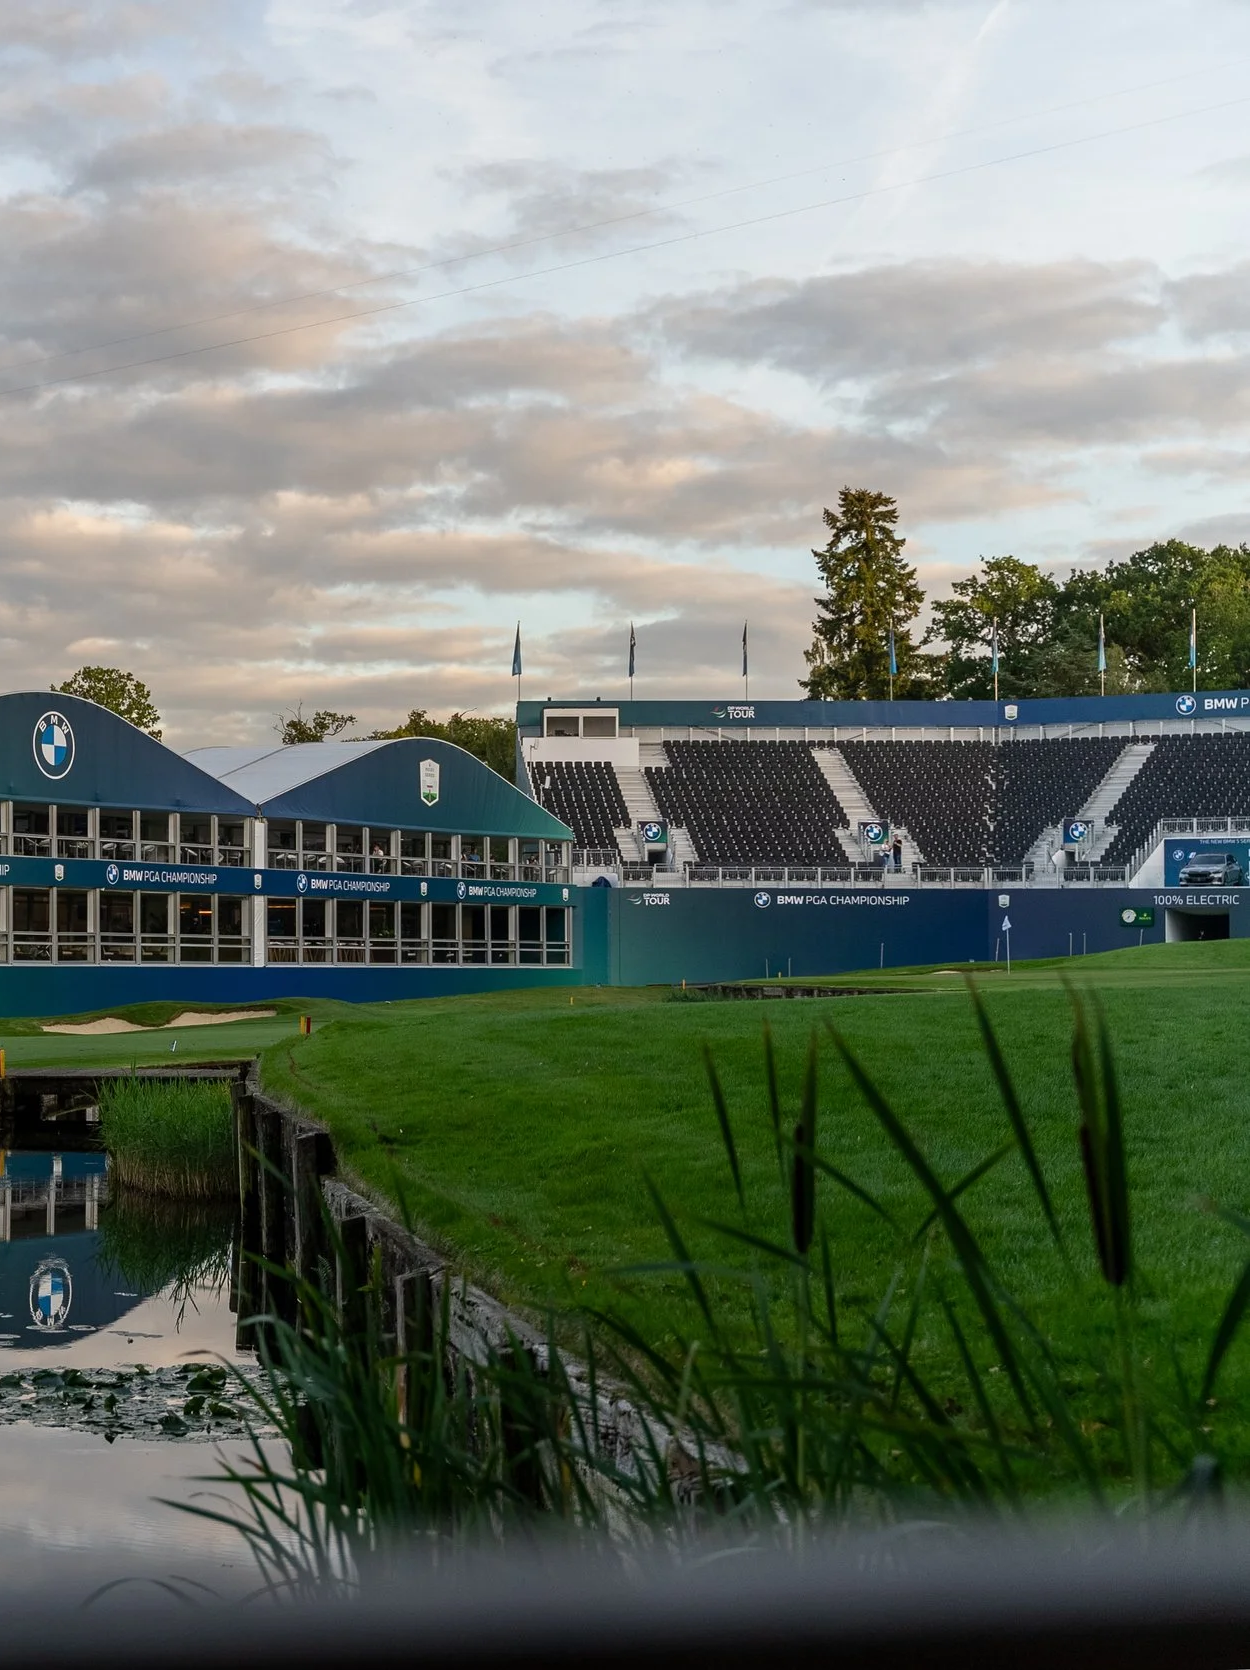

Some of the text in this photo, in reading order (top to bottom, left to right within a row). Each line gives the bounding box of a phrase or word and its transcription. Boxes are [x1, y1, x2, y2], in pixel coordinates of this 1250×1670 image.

[1204, 698, 1238, 710] BMW
[728, 710, 755, 719] TOUR
[39, 715, 70, 734] BMW
[123, 869, 218, 884] BMW PGA CHAMPIONSHIP
[311, 879, 390, 892] BMW PGA CHAMPIONSHIP
[469, 886, 483, 896] BMW
[643, 897, 670, 906] TOUR
[777, 895, 804, 905] BMW
[805, 895, 827, 905] PGA
[829, 895, 910, 905] CHAMPIONSHIP
[1153, 894, 1240, 905] 100% ELECTRIC
